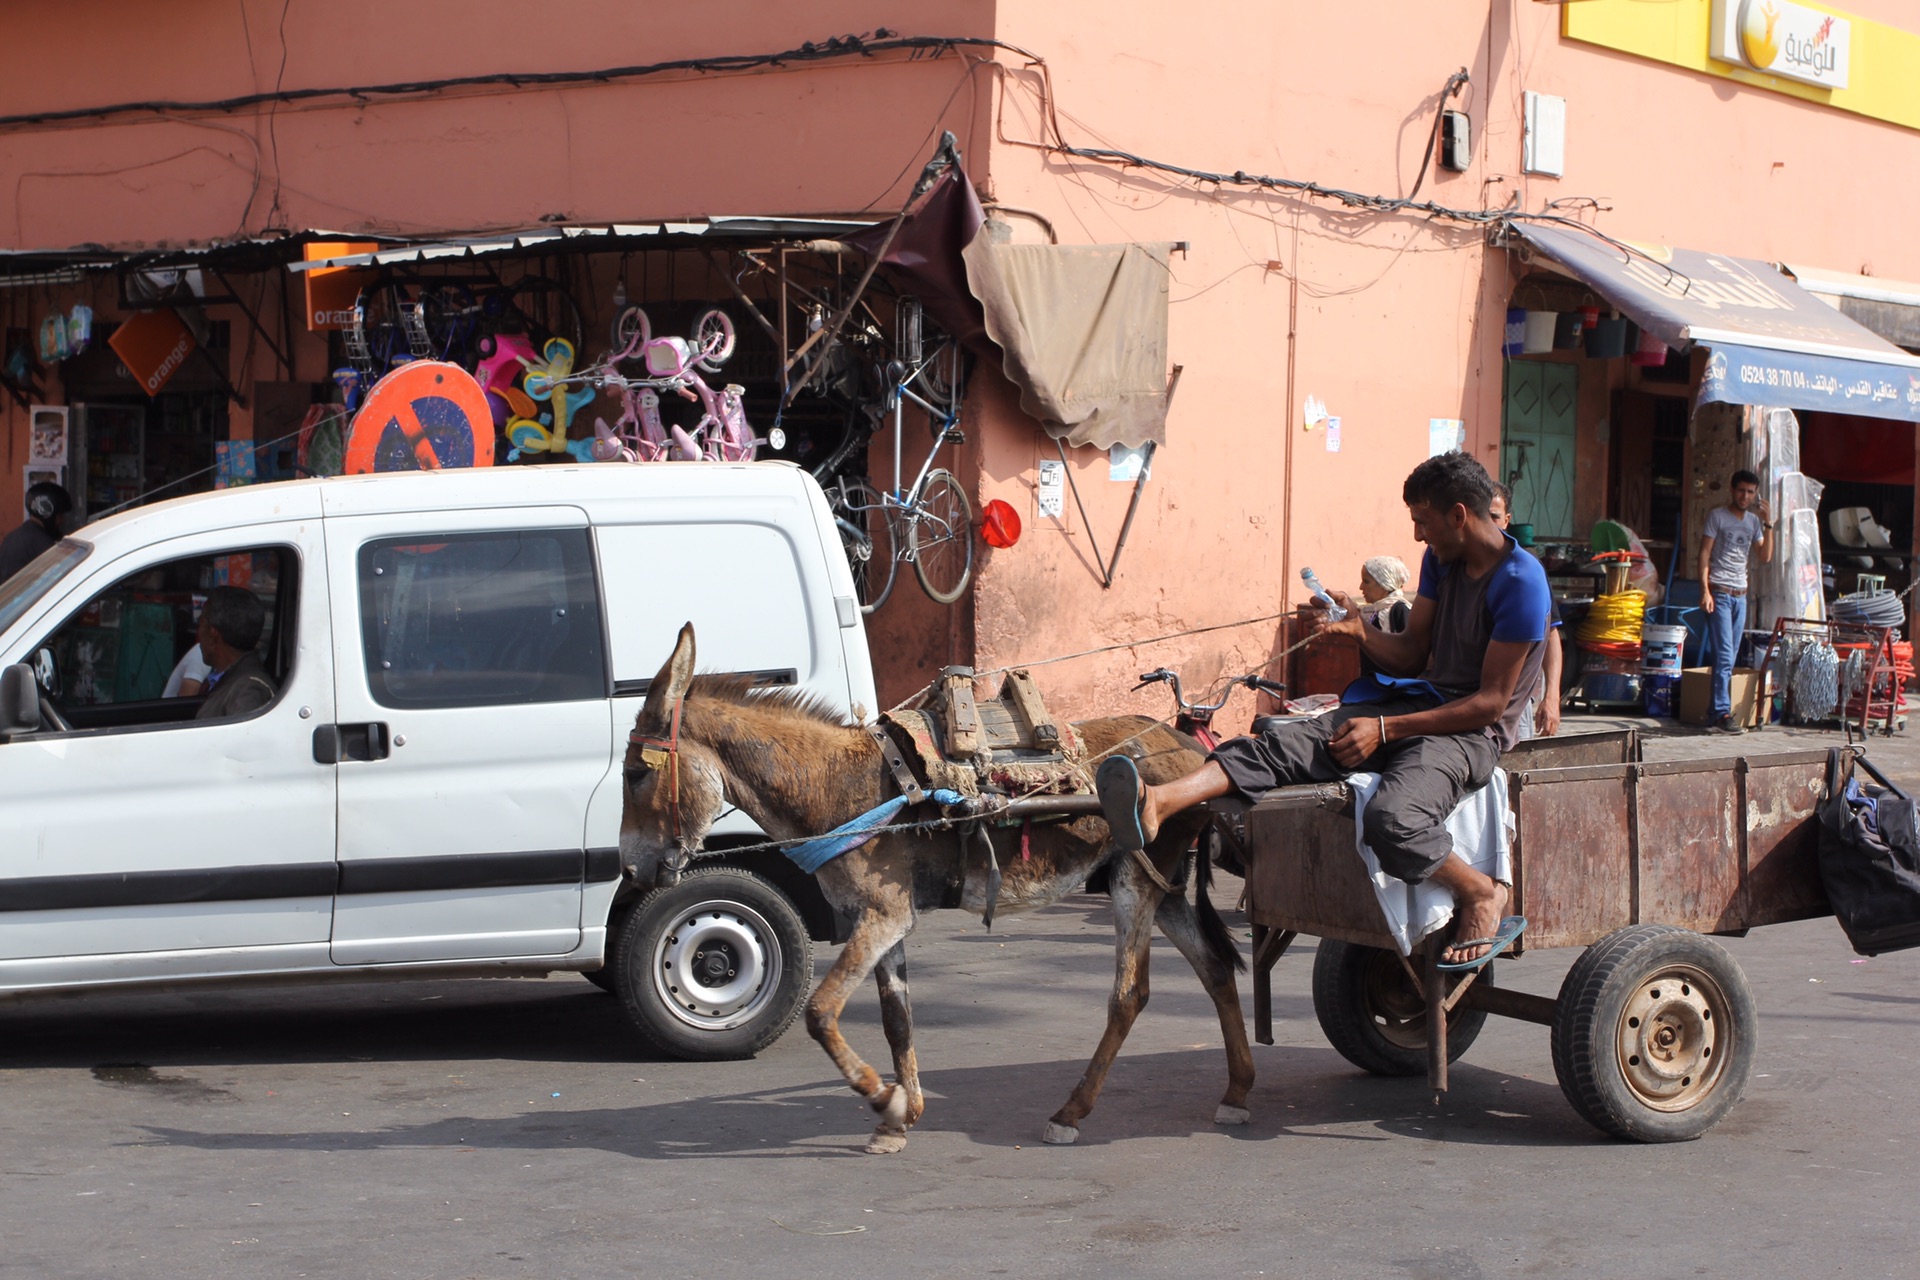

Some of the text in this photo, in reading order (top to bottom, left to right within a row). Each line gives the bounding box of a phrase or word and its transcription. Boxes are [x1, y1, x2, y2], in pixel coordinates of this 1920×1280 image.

[148, 340, 188, 389] orange
[1740, 364, 1765, 384] 0524
[1766, 368, 1779, 386] 38
[1779, 369, 1792, 388] 70
[1793, 370, 1805, 389] 04
